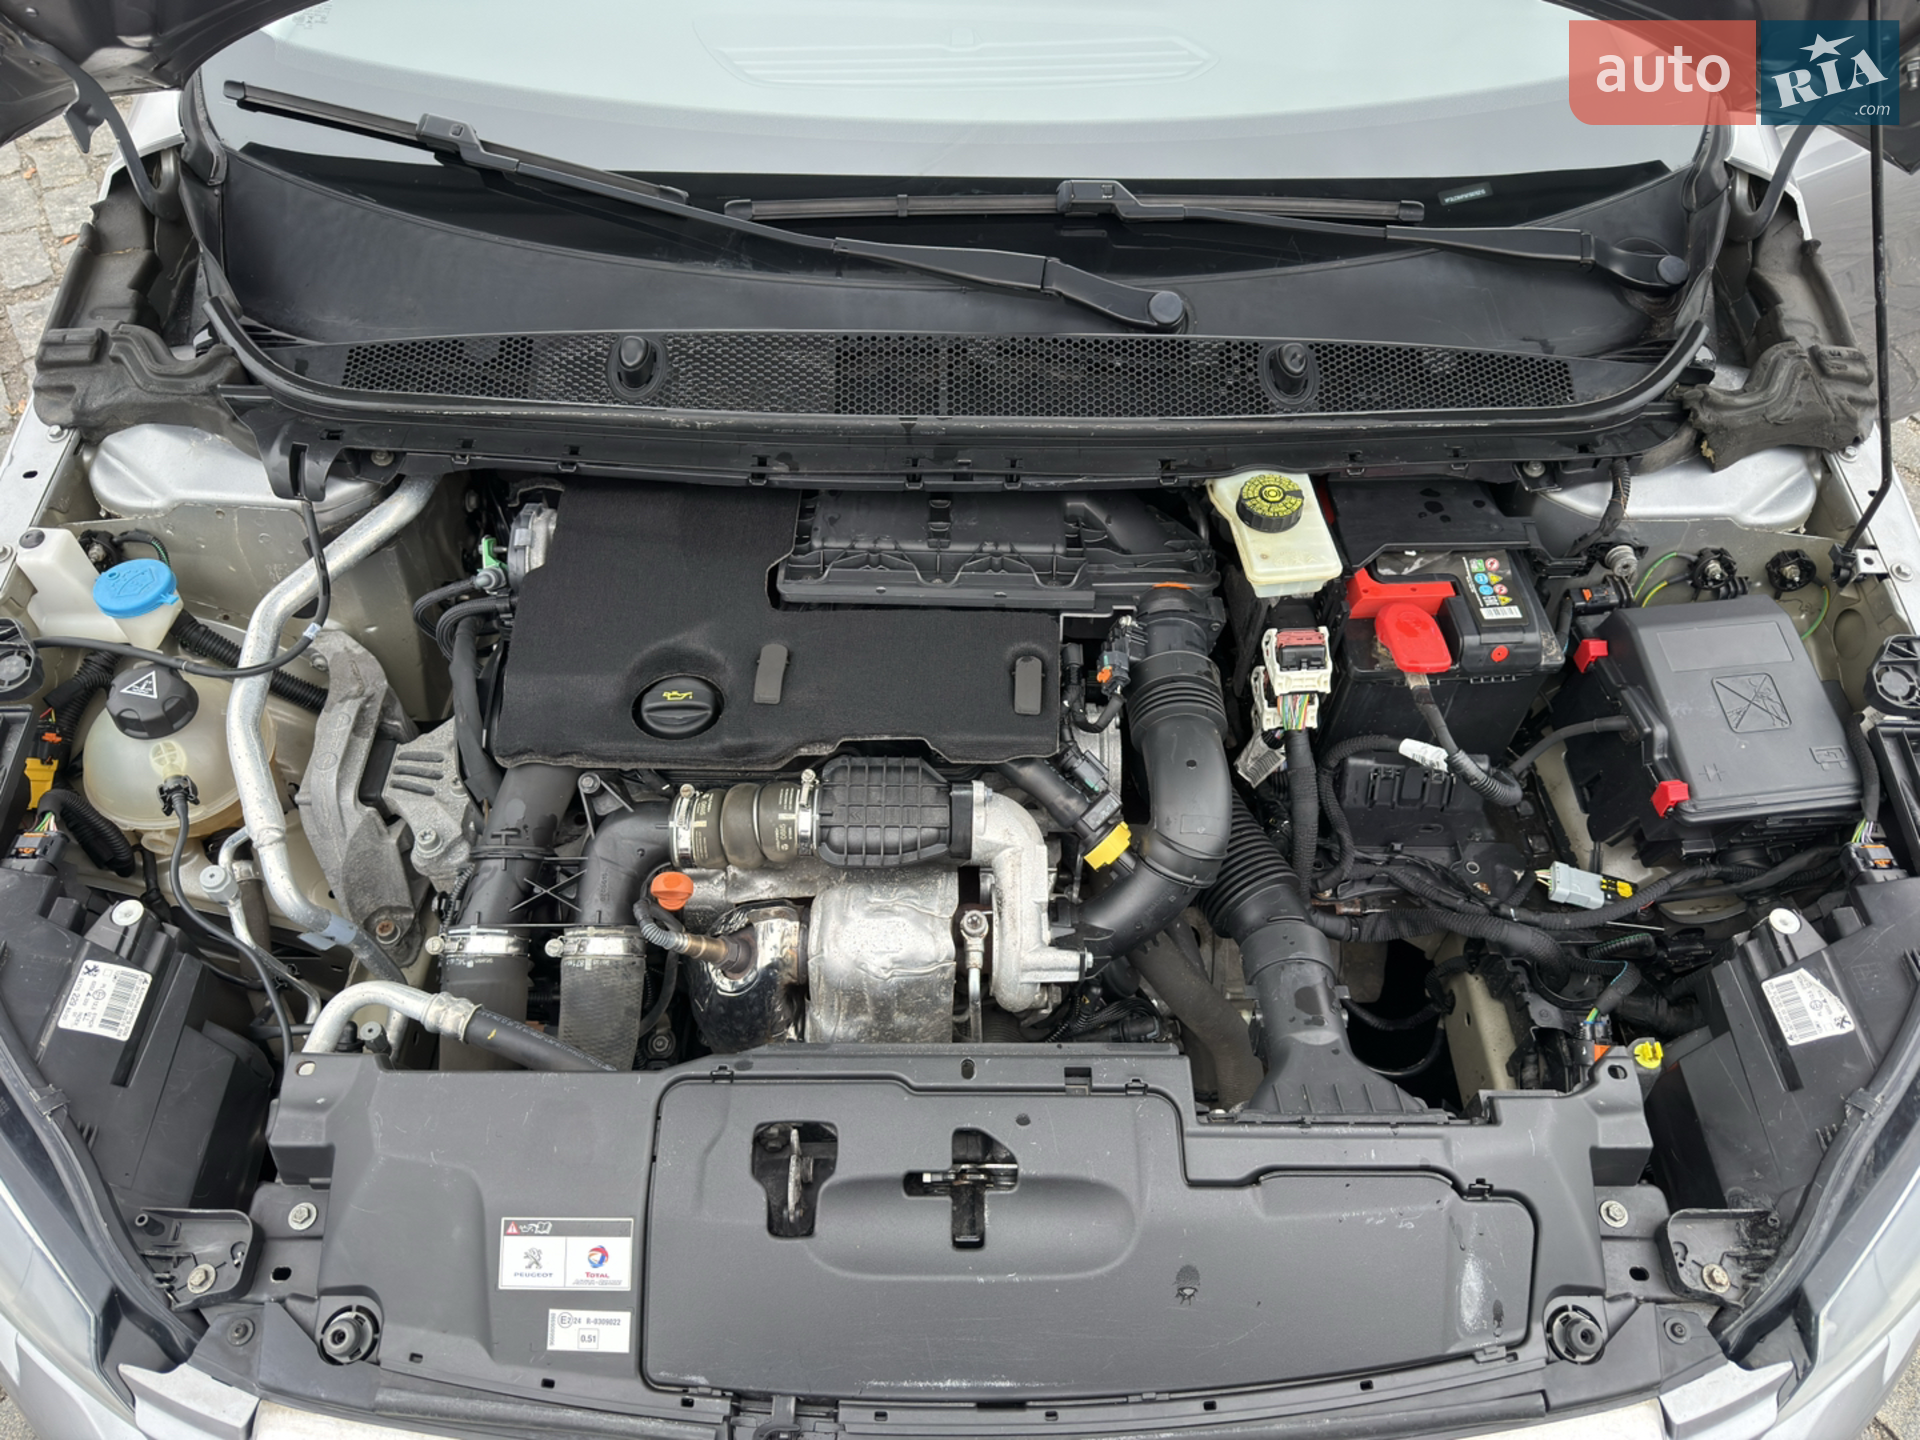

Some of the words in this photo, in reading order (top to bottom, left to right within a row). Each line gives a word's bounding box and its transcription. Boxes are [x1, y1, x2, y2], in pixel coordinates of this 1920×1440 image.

[585, 1271, 610, 1279] TOTAL
[573, 1317, 582, 1325] 24
[580, 1334, 597, 1344] 0.51
